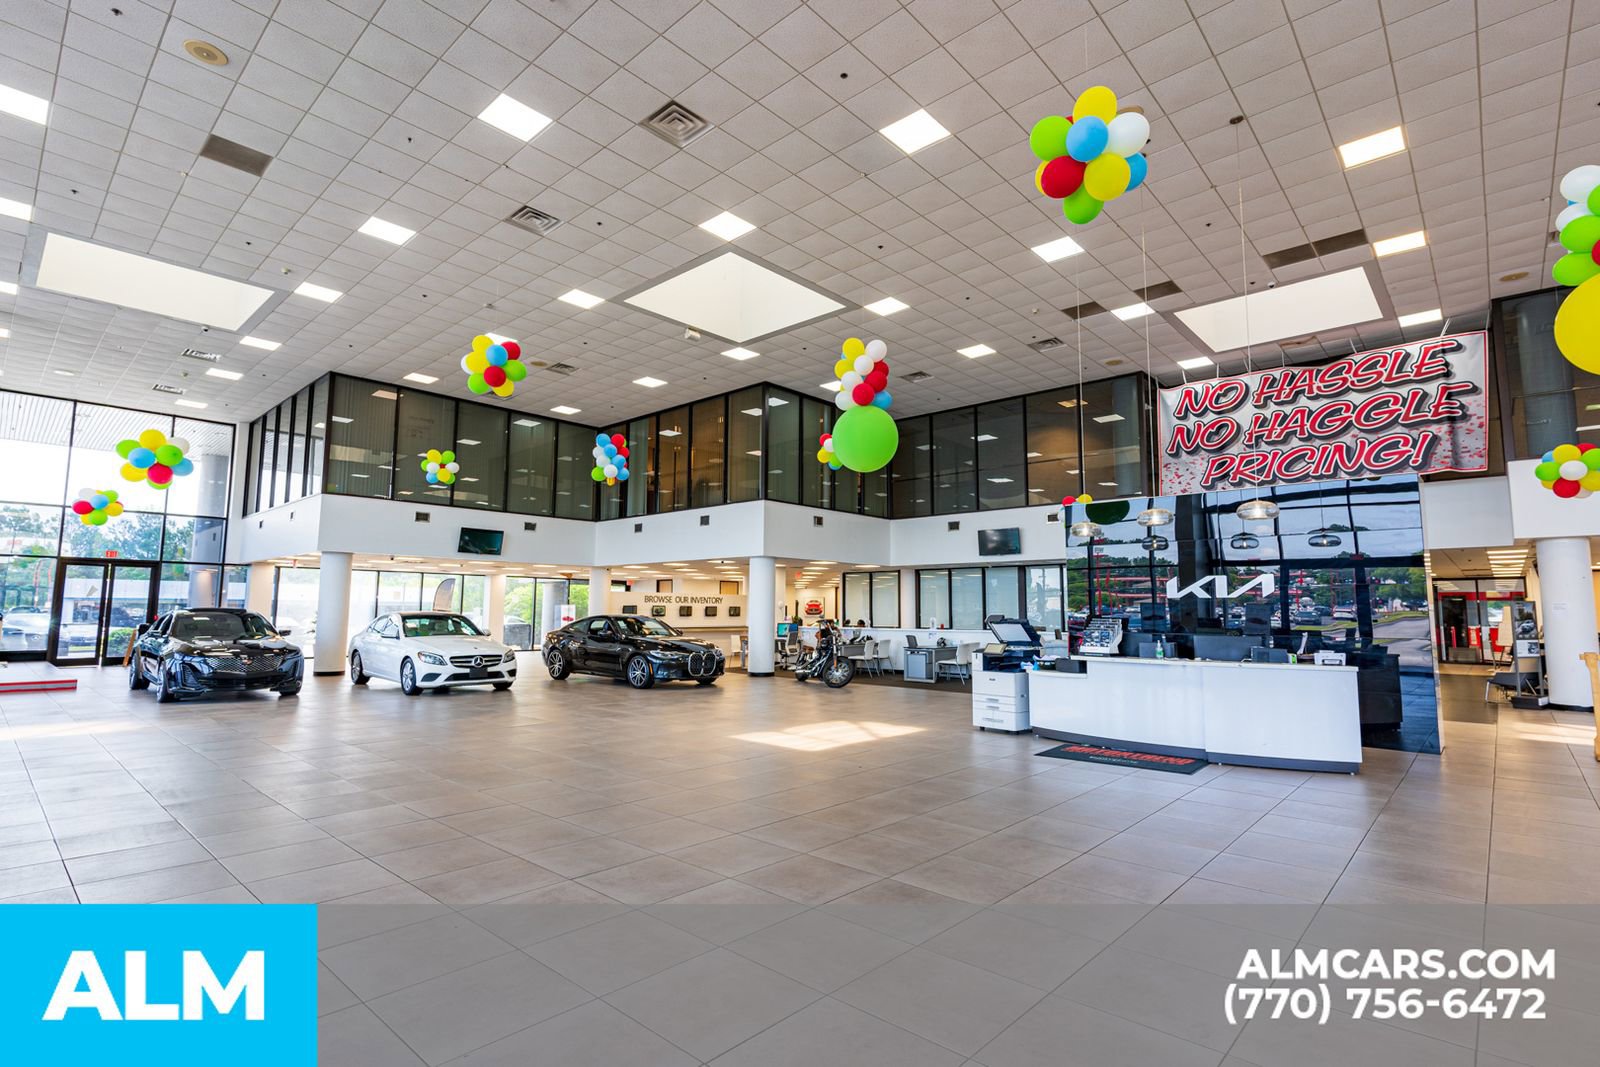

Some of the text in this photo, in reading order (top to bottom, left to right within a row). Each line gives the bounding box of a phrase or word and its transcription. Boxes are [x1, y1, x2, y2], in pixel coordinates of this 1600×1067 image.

[1174, 340, 1459, 419] NO HASSLE
[1167, 382, 1477, 455] NO HAGGLE
[1200, 431, 1434, 488] PRICING!
[644, 595, 723, 605] BROWSE OUR INVENTORY
[1166, 573, 1275, 599] KIA
